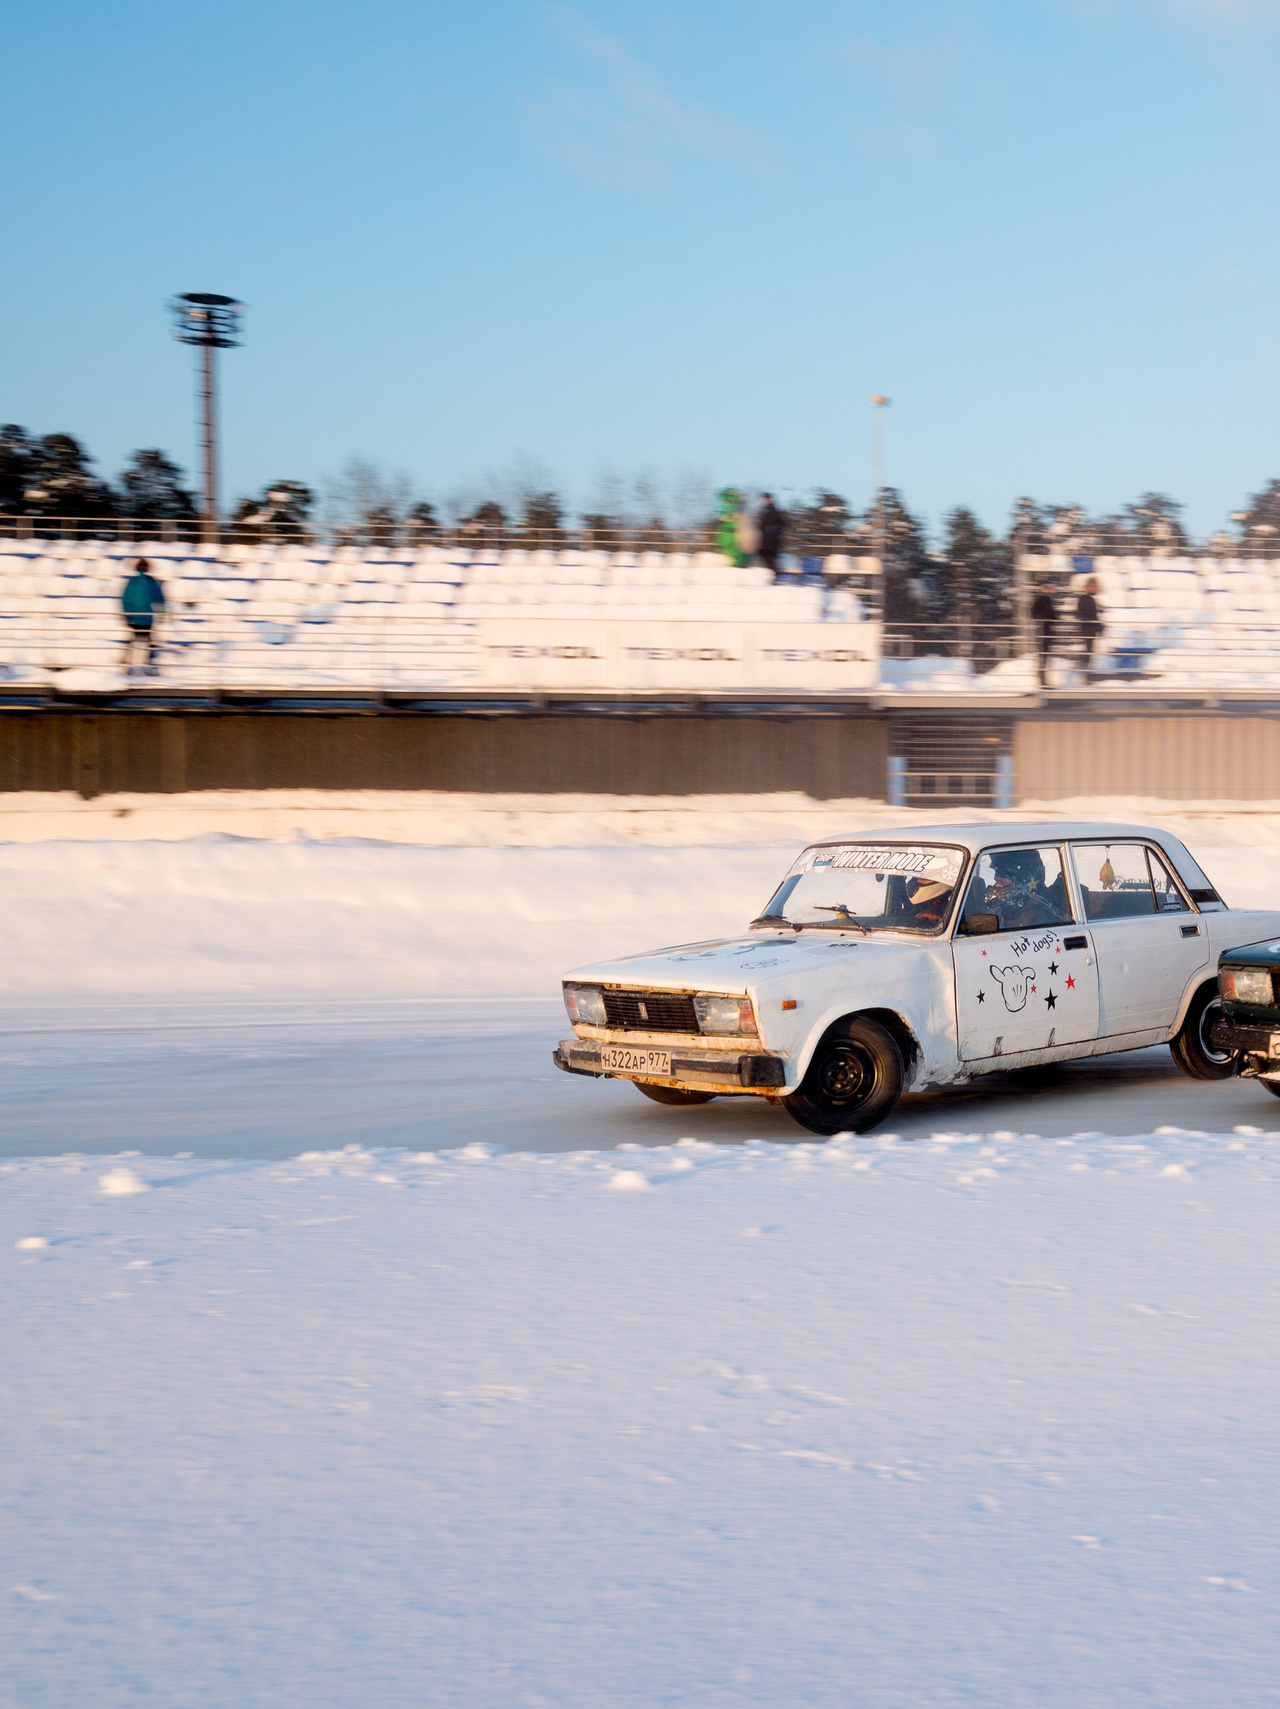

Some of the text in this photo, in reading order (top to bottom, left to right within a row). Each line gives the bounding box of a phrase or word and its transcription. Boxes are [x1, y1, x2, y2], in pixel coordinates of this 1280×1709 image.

[832, 851, 892, 869] WINTER
[882, 852, 935, 872] MODE
[1010, 929, 1060, 957] Hot dogs!
[648, 1052, 667, 1067] 977
